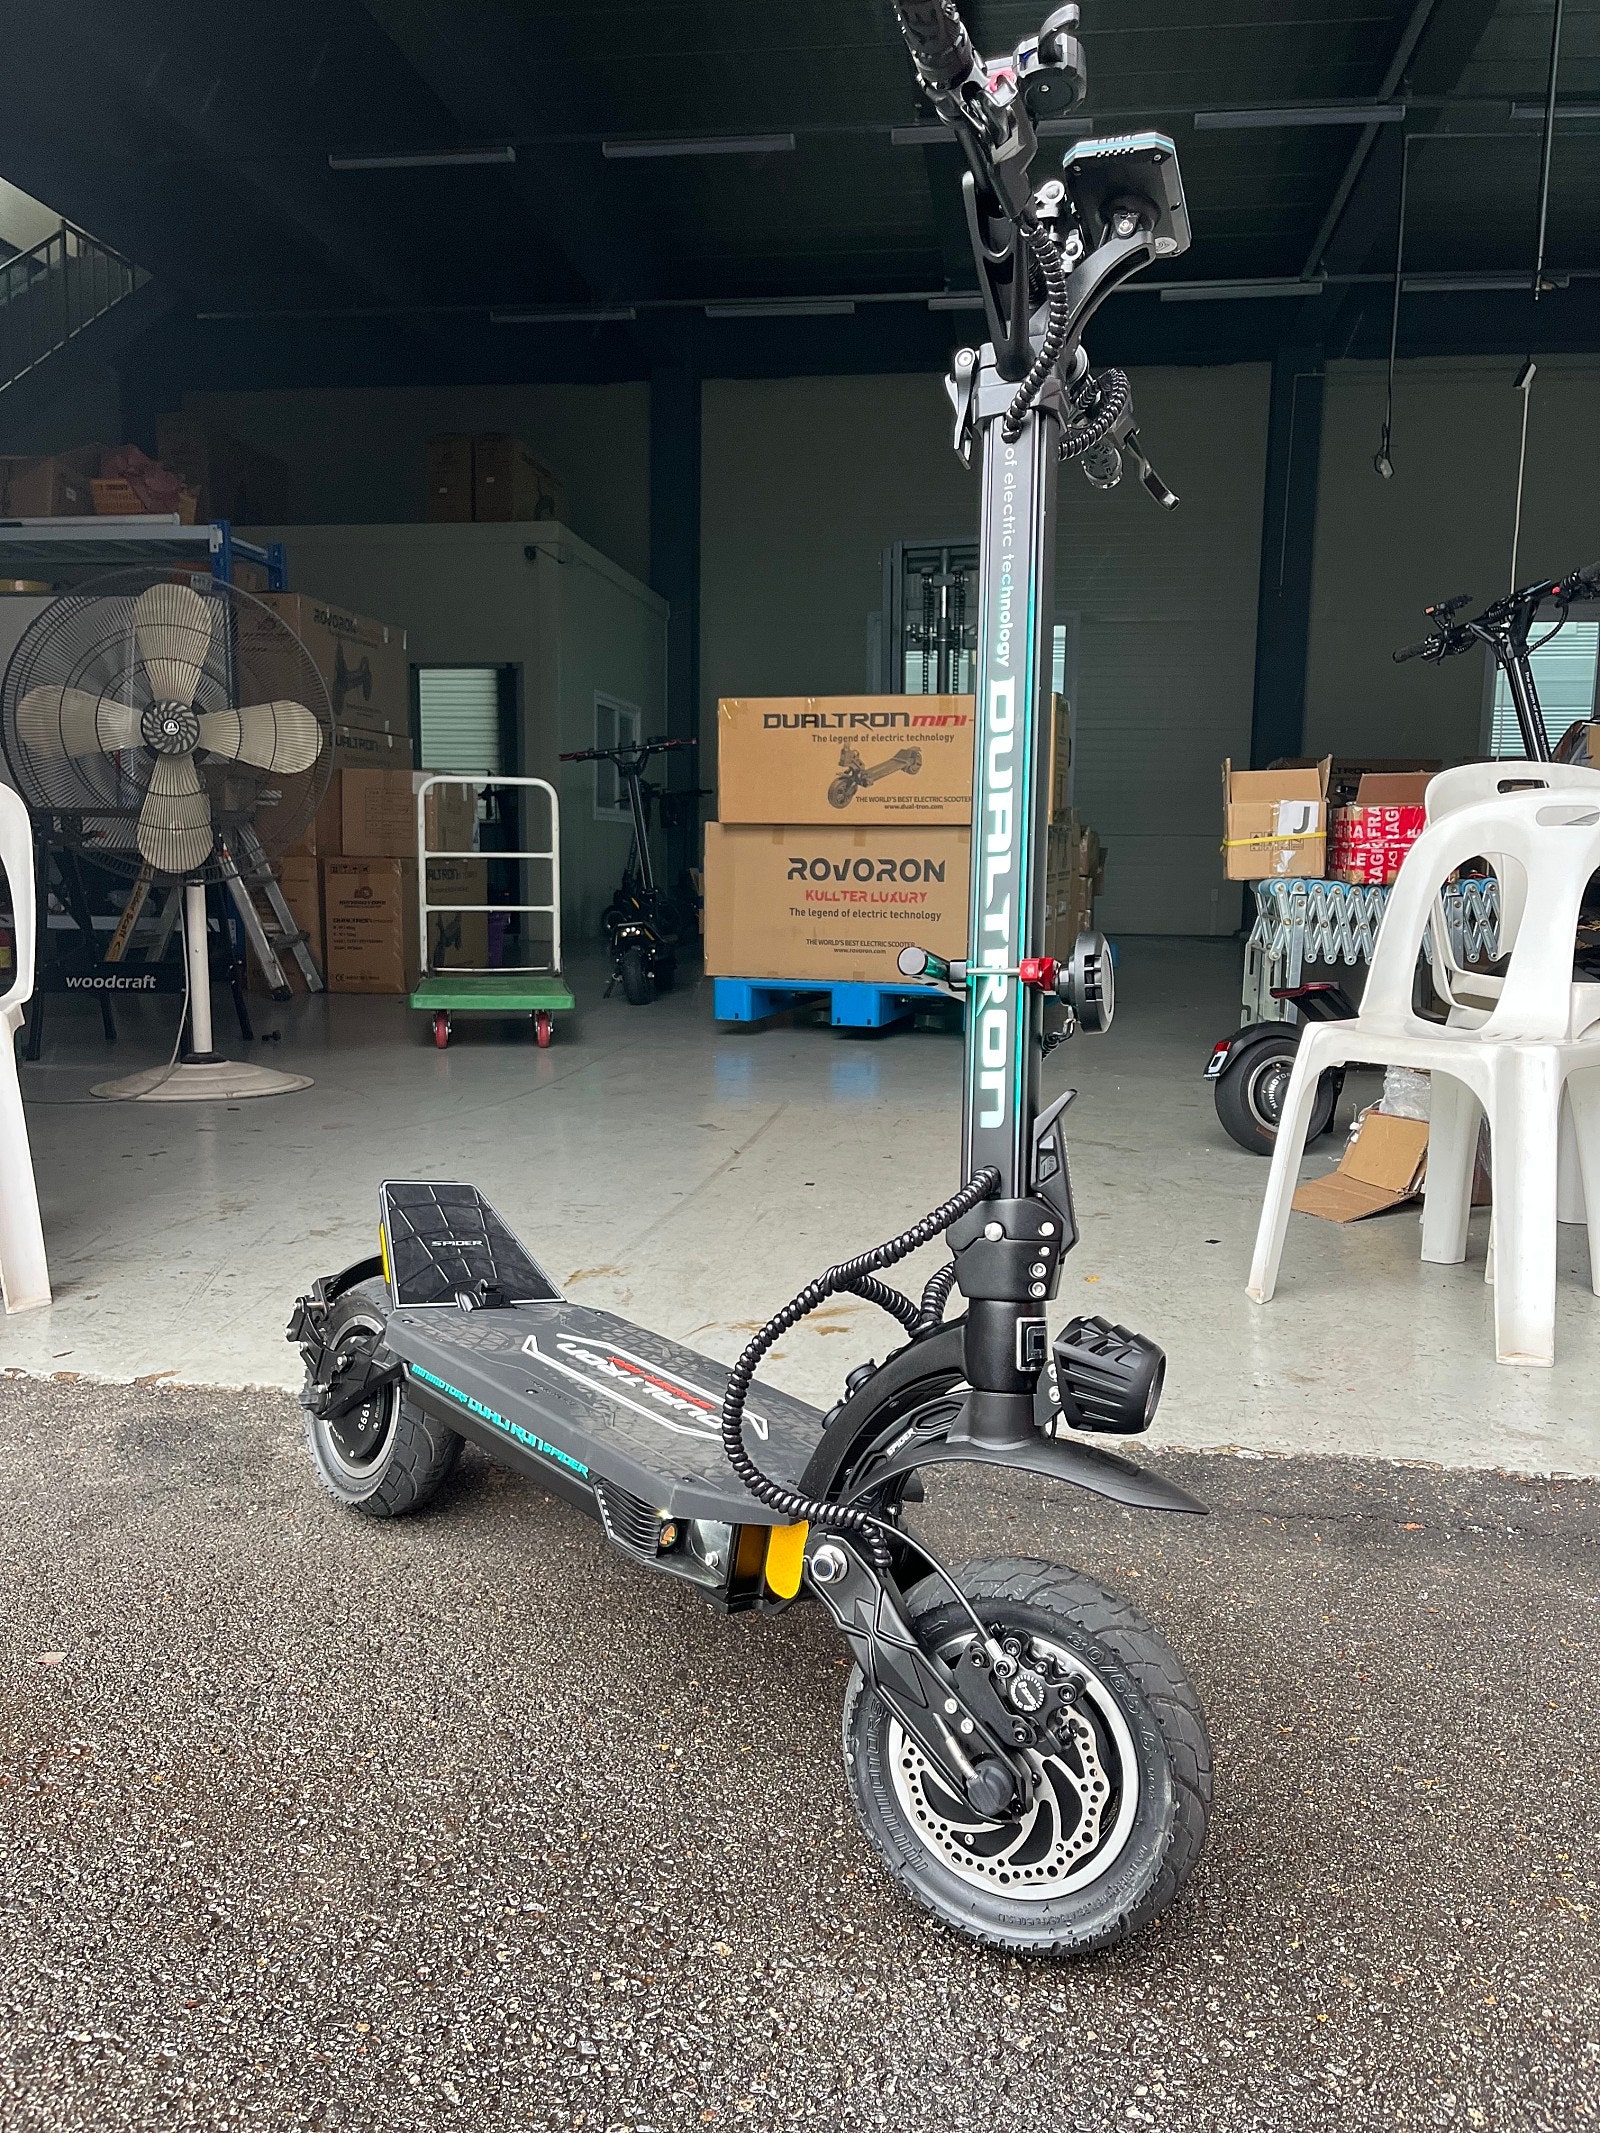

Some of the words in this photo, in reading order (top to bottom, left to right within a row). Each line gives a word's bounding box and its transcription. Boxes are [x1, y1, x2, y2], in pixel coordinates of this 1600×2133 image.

[1004, 447, 1018, 466] of
[1002, 472, 1017, 547] electric
[996, 553, 1015, 668] technology
[763, 711, 910, 731] DUALTRON
[811, 734, 828, 742] The
[829, 733, 860, 744] legend
[861, 733, 871, 742] of
[871, 733, 904, 742] electric
[906, 733, 955, 743] technology
[1293, 806, 1311, 834] J
[787, 857, 946, 883] ROVORON
[805, 889, 868, 903] KULLTER
[870, 890, 928, 904] LUXURY
[978, 676, 1017, 1129] DUALTRON
[789, 907, 806, 917] The
[807, 907, 839, 919] legend
[841, 908, 851, 918] of
[852, 908, 888, 919] electric
[889, 909, 942, 921] technology
[806, 938, 818, 946] THE
[817, 938, 845, 947] WORLD'S
[845, 939, 860, 947] BEST
[860, 939, 887, 947] ELECTRIC
[887, 940, 916, 948] SCOOTER
[65, 974, 157, 990] woodcraft
[885, 1428, 917, 1457] SPIDER
[543, 1443, 590, 1480] SPIDER
